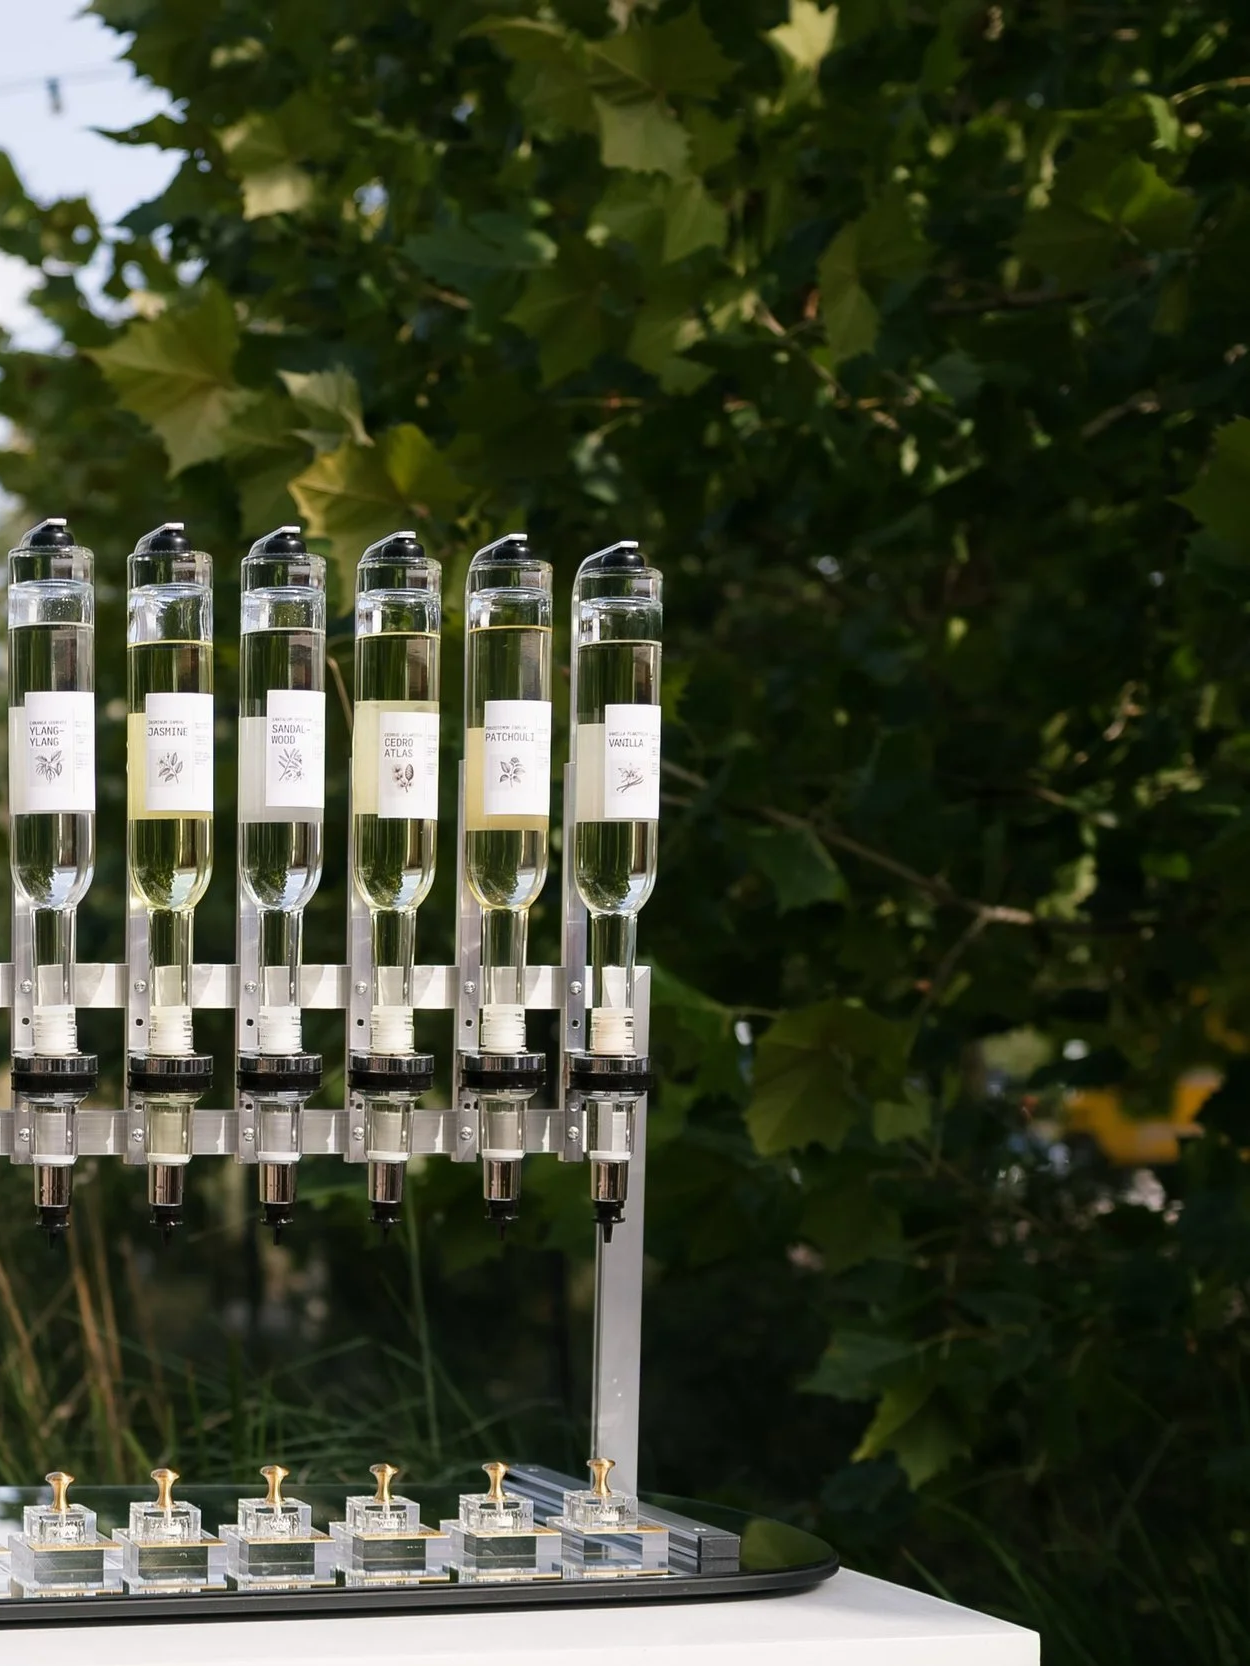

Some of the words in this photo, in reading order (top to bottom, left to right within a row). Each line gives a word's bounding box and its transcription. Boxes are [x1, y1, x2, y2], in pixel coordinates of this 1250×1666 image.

[147, 727, 188, 737] JASMINE
[485, 732, 535, 742] PATCHOULI
[30, 737, 59, 747] YLANG
[271, 735, 296, 744] WOOD
[384, 738, 414, 748] CEDRO
[608, 738, 644, 748] VANILLA
[384, 749, 414, 758] ATLAS
